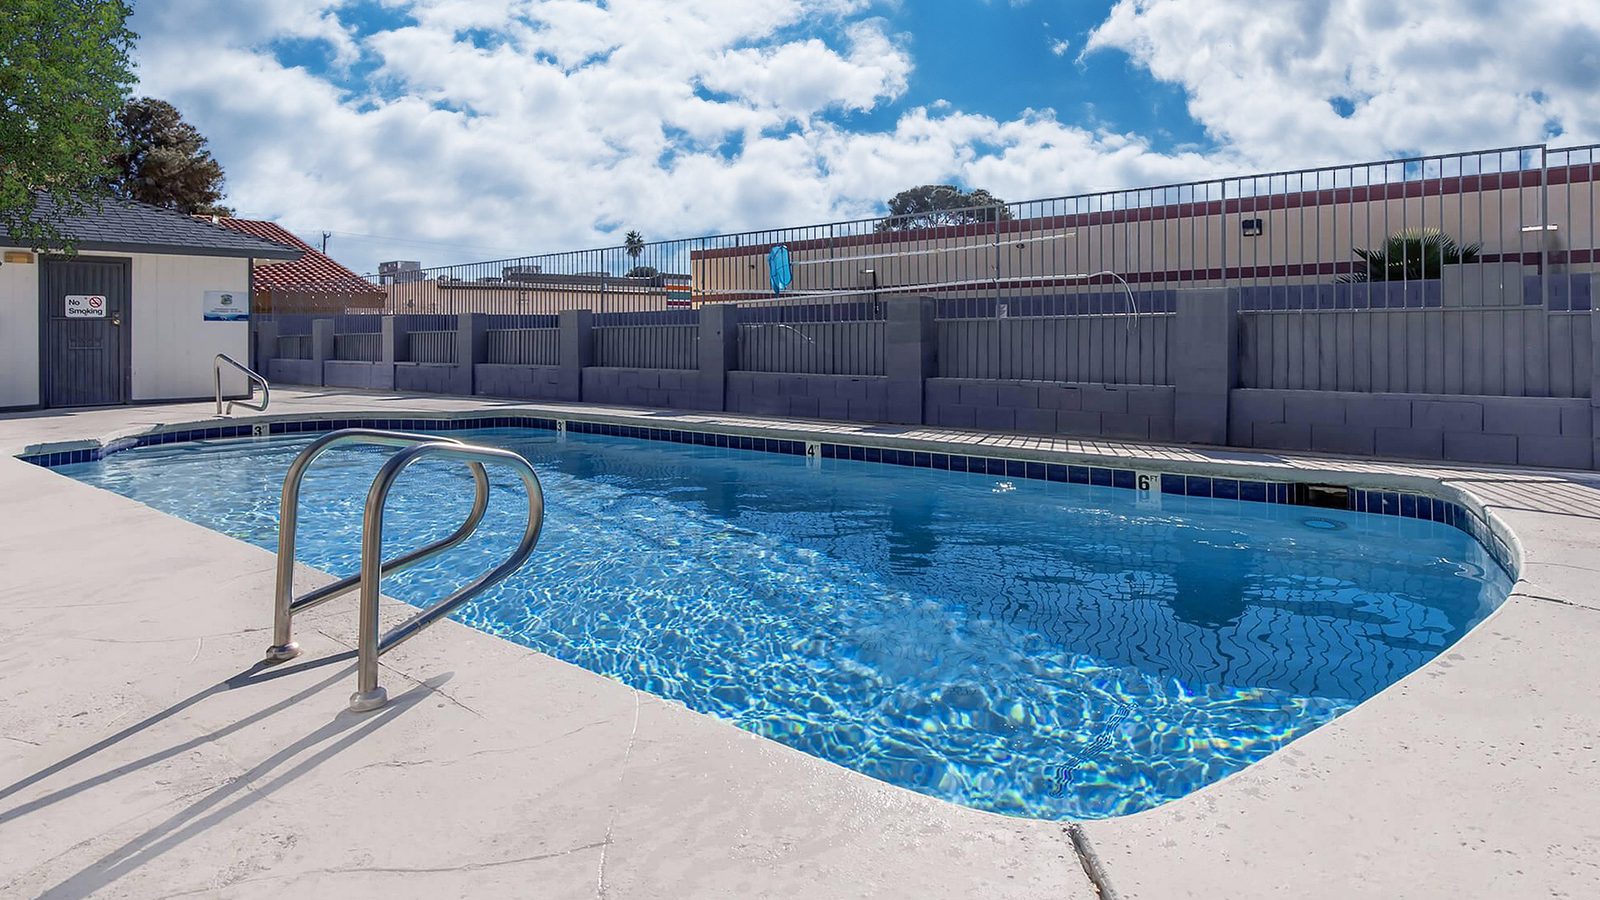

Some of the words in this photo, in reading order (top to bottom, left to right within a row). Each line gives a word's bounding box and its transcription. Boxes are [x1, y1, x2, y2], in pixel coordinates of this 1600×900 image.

[69, 308, 103, 316] Smoking
[254, 425, 262, 436] 3
[557, 421, 562, 432] 3
[808, 444, 815, 456] 4
[1138, 474, 1150, 491] 6
